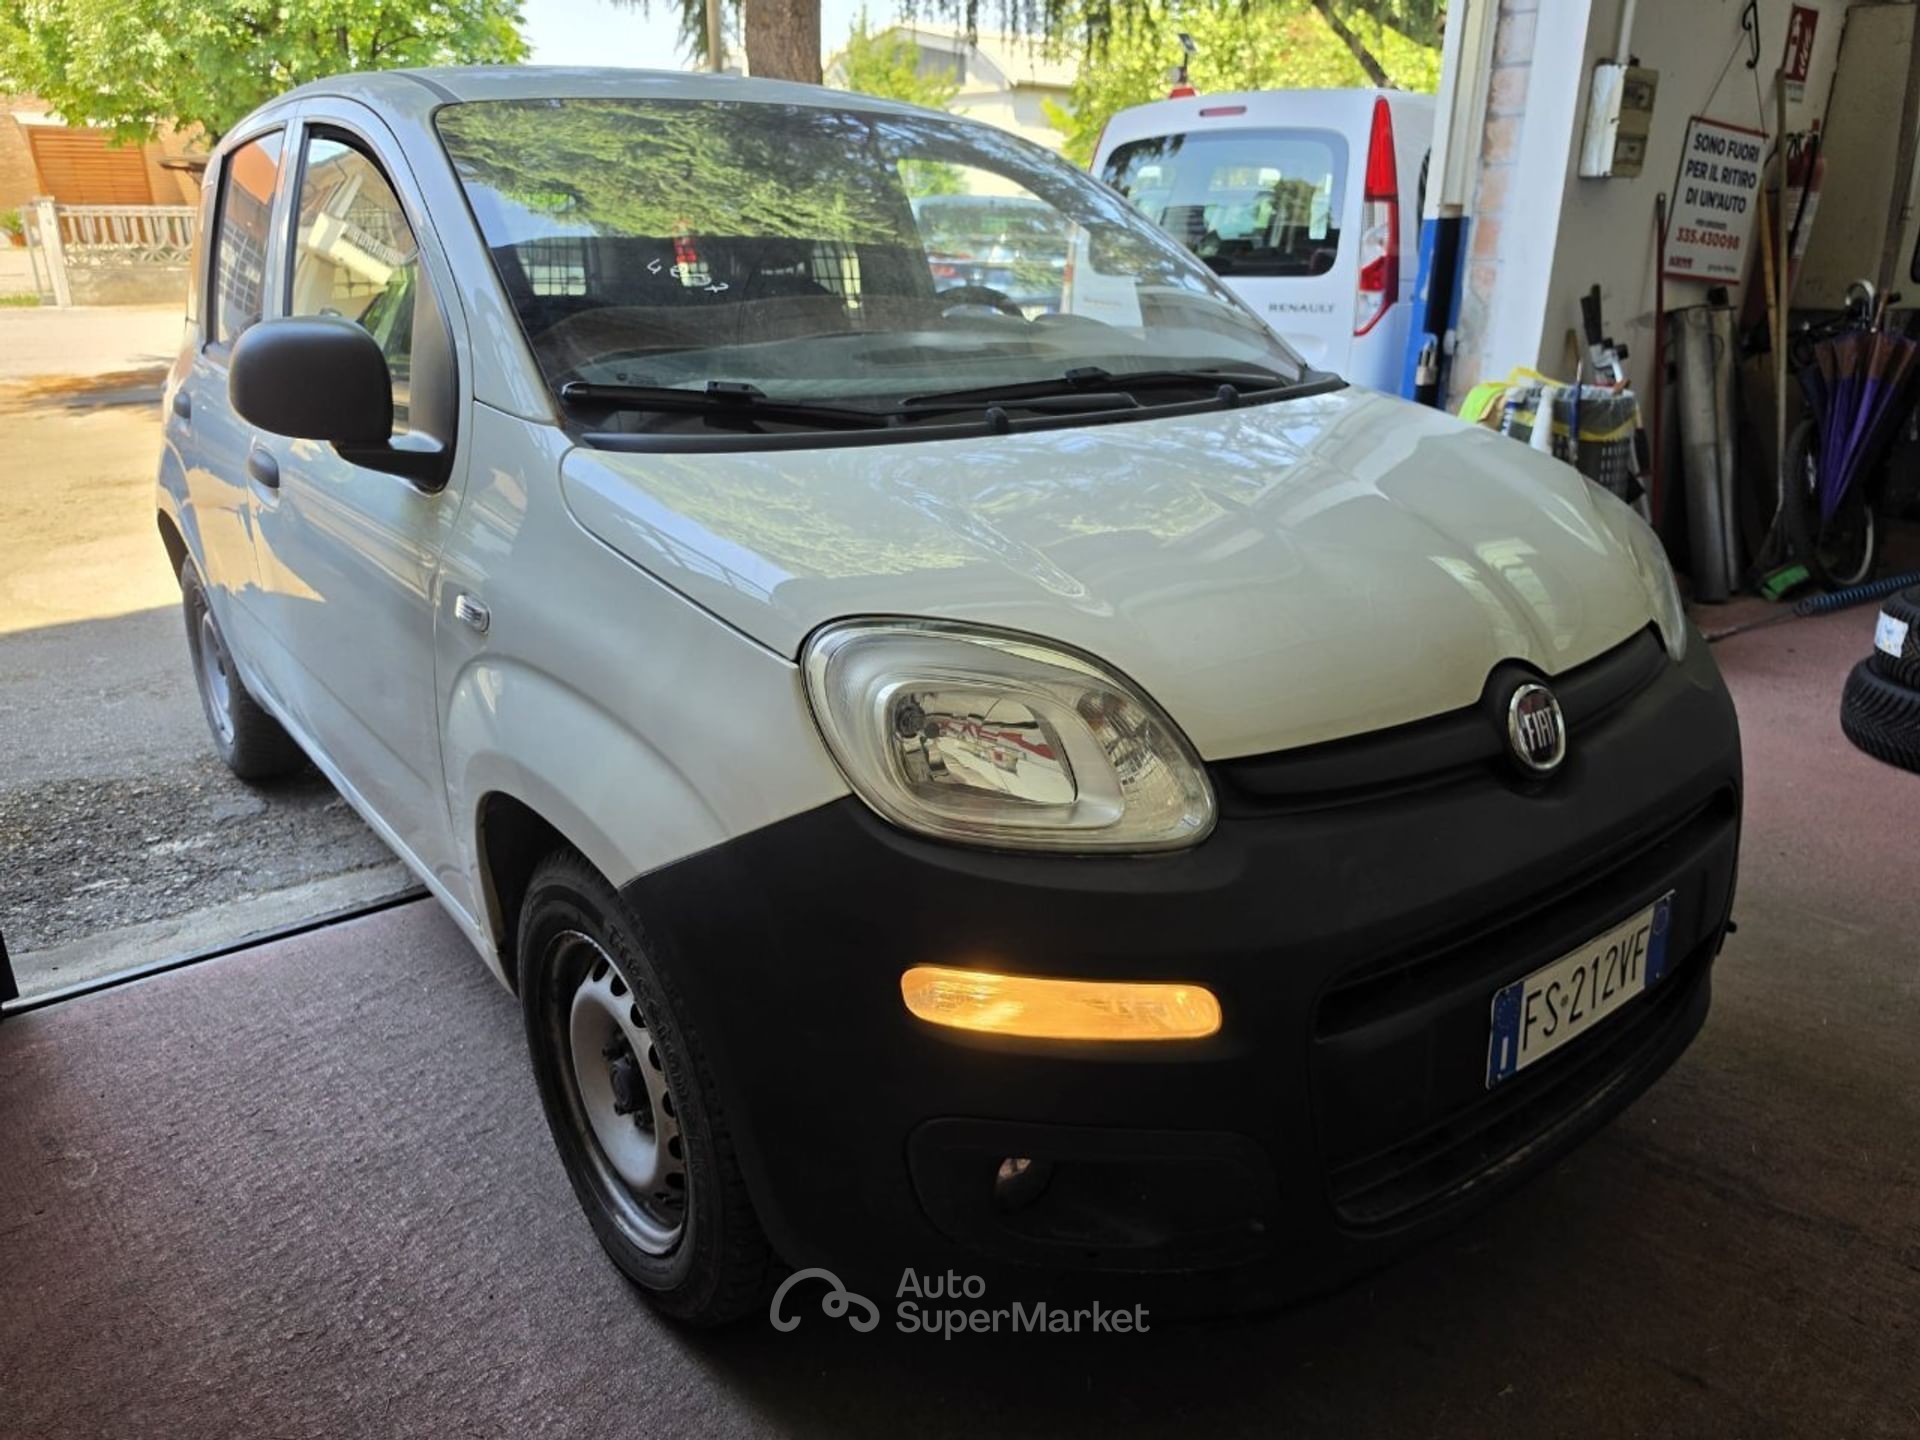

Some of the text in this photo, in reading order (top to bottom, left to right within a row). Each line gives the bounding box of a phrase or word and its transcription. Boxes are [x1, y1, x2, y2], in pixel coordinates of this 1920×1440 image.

[1694, 133, 1760, 163] SONO FUORI
[1686, 159, 1757, 189] PER IL RITIRO
[1685, 187, 1747, 213] DI UN'AUTO
[1269, 303, 1334, 313] RENAULT
[1523, 707, 1555, 752] FIAT
